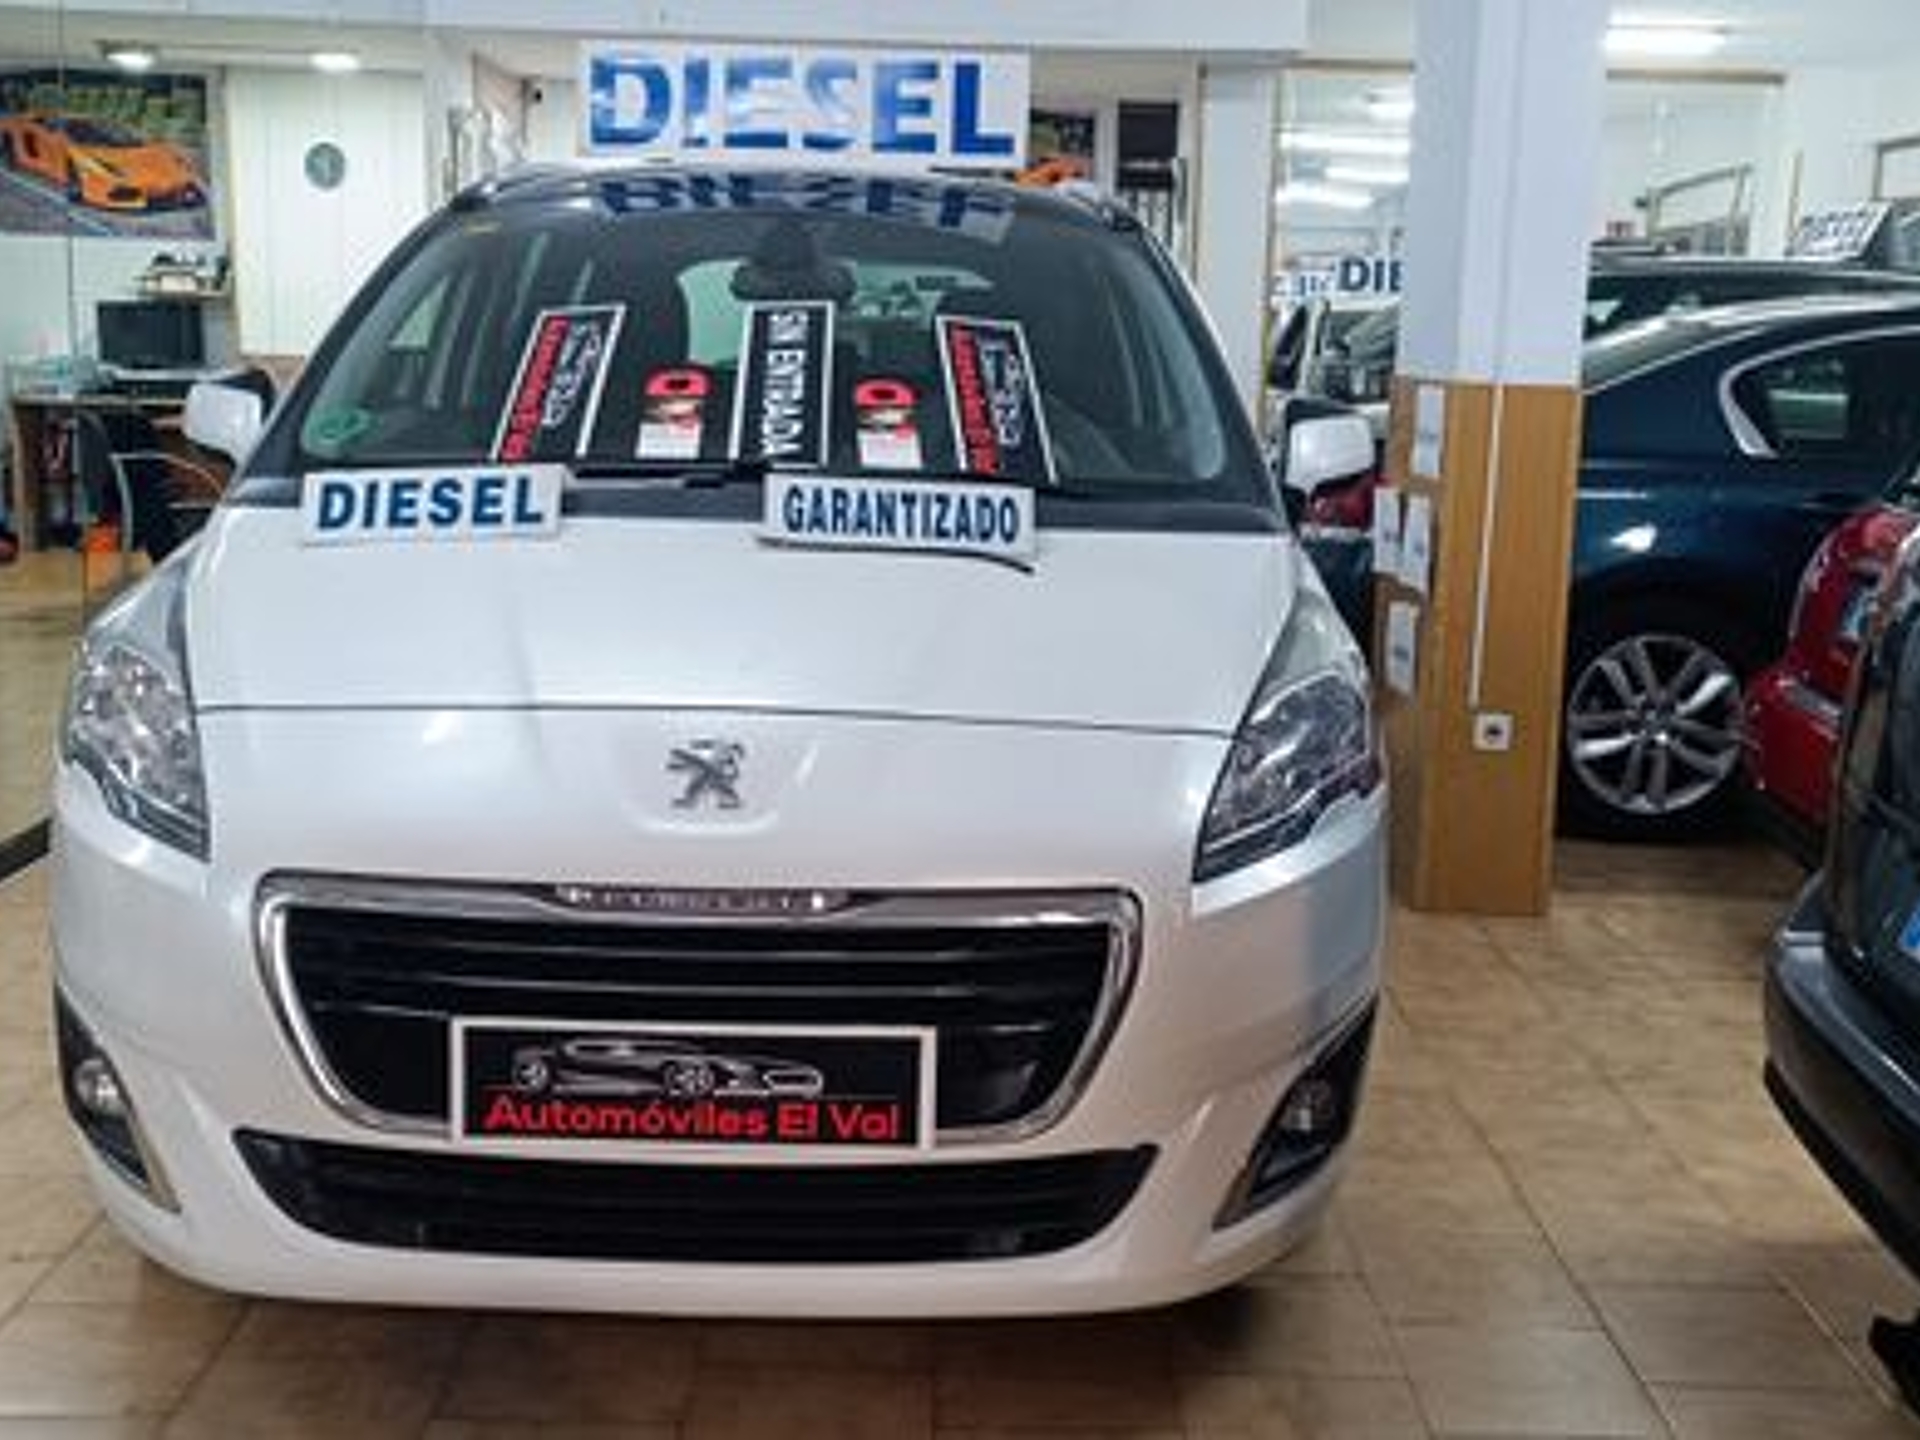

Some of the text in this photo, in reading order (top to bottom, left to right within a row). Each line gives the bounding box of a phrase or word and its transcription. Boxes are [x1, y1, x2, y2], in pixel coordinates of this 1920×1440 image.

[590, 56, 1016, 154] DIESEL
[759, 349, 805, 457] ENTRADA
[318, 476, 544, 530] DIESEL
[783, 484, 1020, 543] GARANTIZADO
[484, 1093, 769, 1137] Automóviles
[778, 1101, 819, 1137] El
